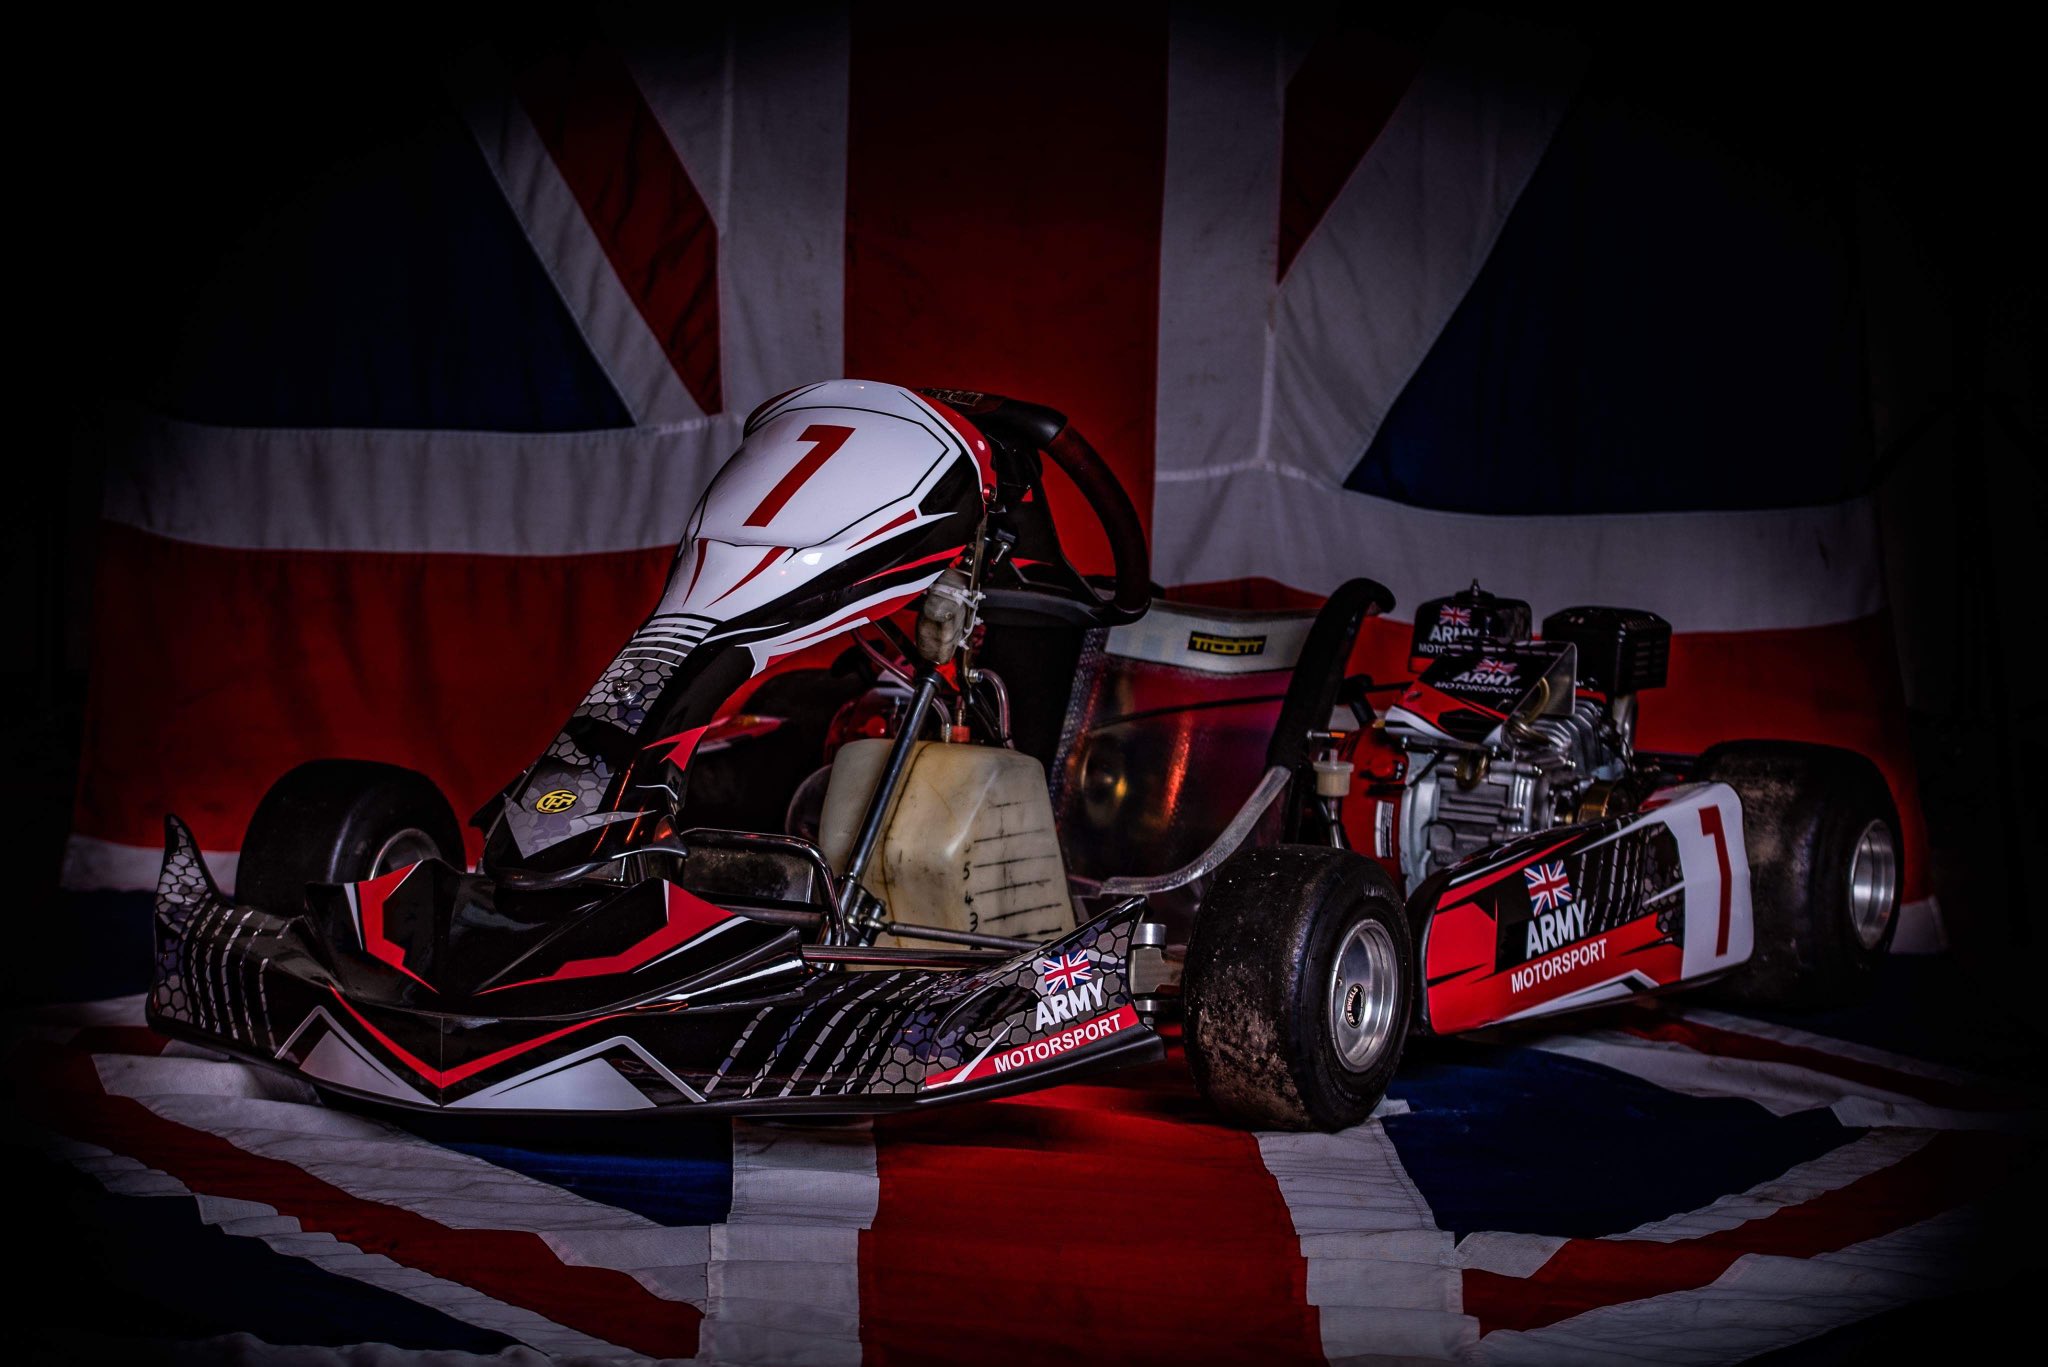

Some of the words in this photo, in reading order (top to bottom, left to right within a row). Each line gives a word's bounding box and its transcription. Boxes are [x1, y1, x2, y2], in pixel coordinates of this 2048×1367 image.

[1434, 681, 1523, 696] MOTORSPORT
[1452, 670, 1522, 686] ARMY
[969, 912, 979, 932] 3
[1526, 899, 1588, 960] ARMY
[1511, 938, 1607, 994] MOTORSPORT
[1035, 977, 1103, 1032] ARMY
[994, 1013, 1121, 1074] MOTORSPORT
